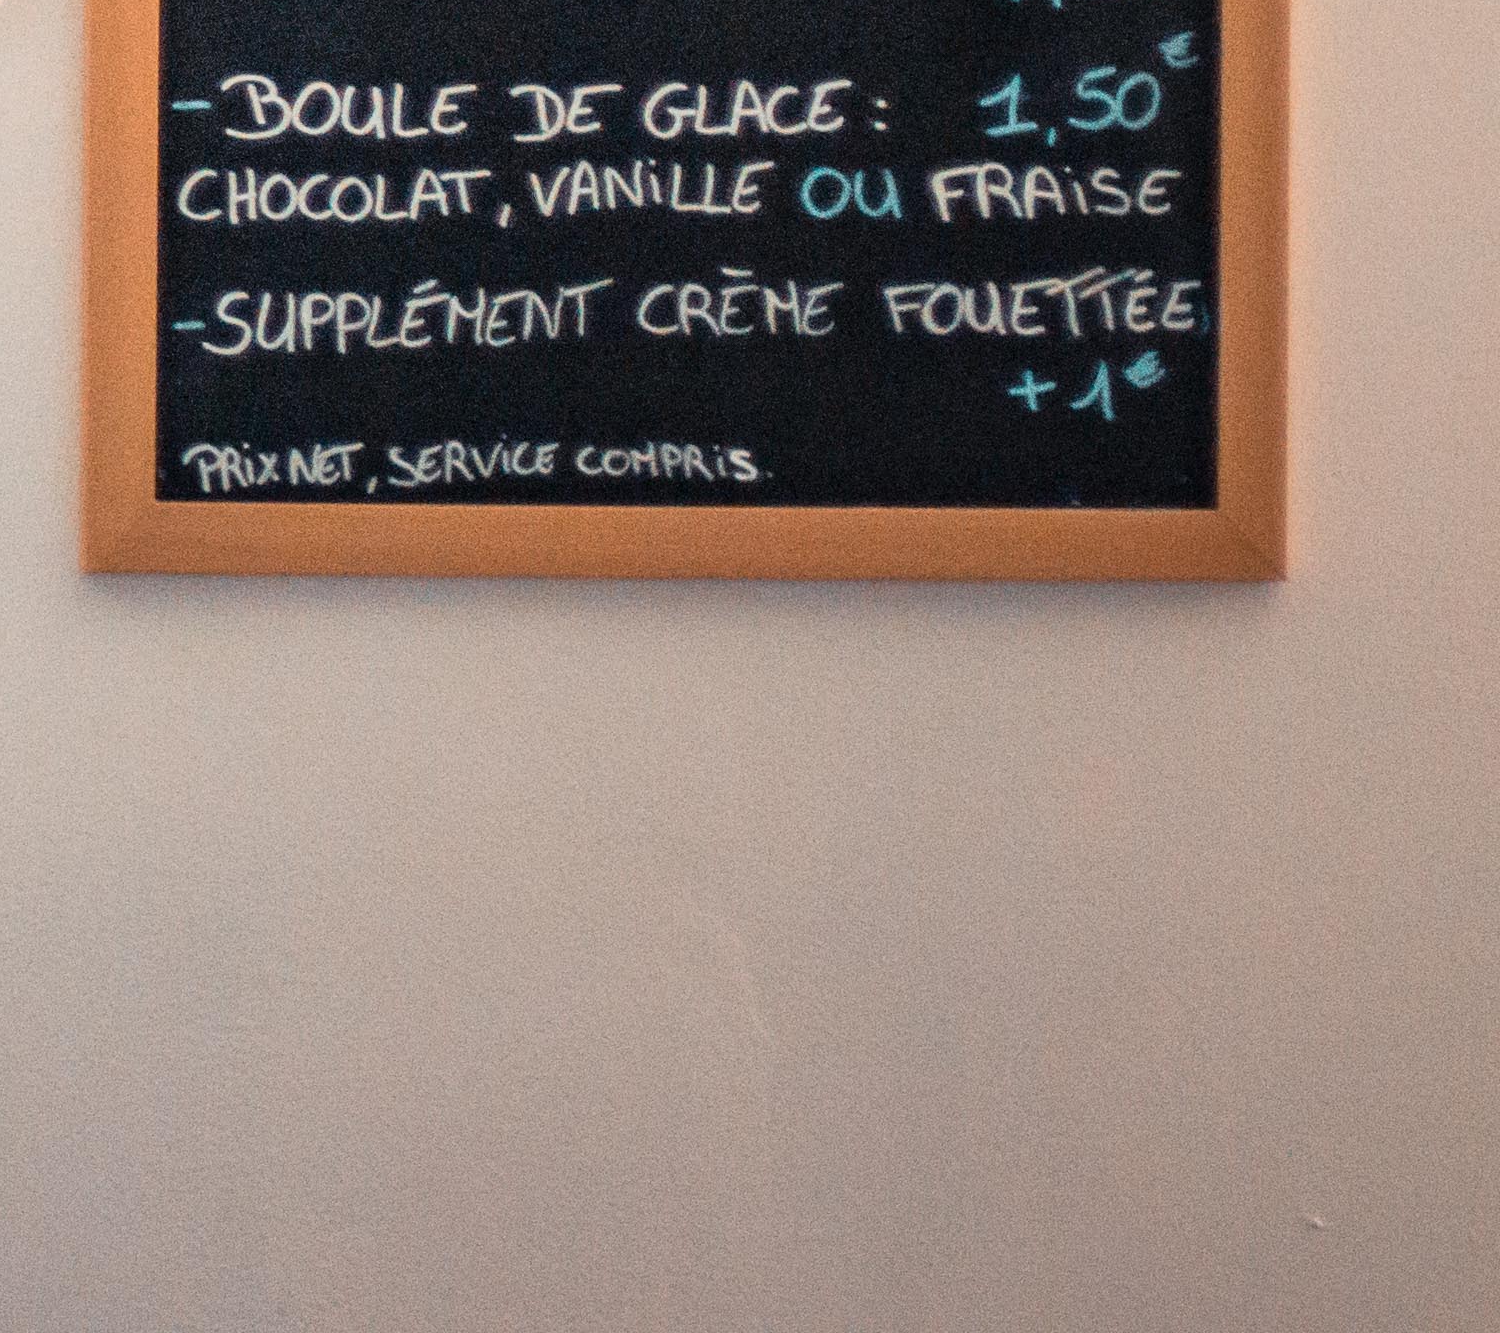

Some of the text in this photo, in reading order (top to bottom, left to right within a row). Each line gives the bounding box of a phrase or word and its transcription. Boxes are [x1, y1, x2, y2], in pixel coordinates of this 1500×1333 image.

[508, 82, 623, 144] DE
[176, 167, 512, 228] CHOCOLAT,
[799, 166, 902, 219] OU
[636, 266, 843, 336] CRÈME
